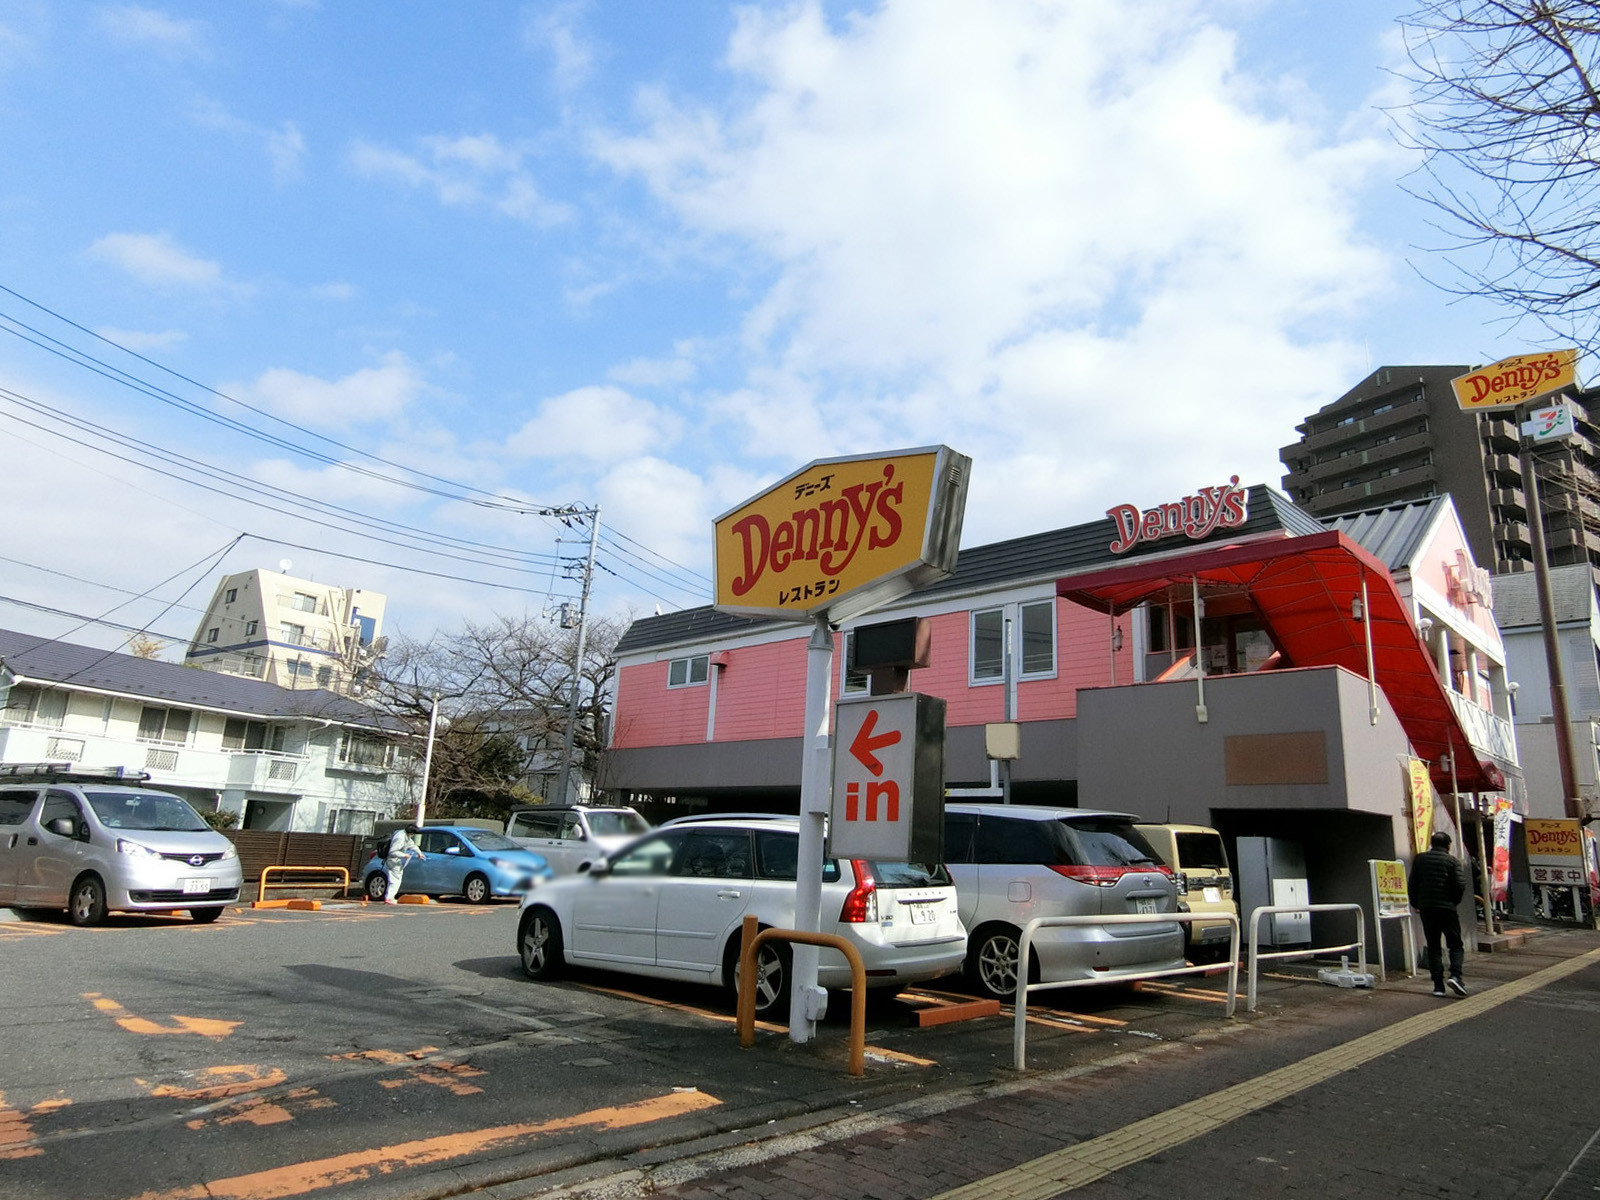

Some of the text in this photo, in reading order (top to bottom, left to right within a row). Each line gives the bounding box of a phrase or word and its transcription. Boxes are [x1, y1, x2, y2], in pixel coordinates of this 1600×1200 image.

[1465, 354, 1561, 403] Denny's
[1495, 390, 1537, 404] レストラン
[794, 474, 835, 500] デニーズ
[1105, 474, 1247, 554] Denny's
[731, 463, 904, 597] Denny's
[778, 579, 840, 606] レストラン
[846, 780, 900, 822] in
[1527, 828, 1579, 846] Denny's
[1537, 846, 1571, 854] レストラン
[1533, 867, 1581, 882] 営業中
